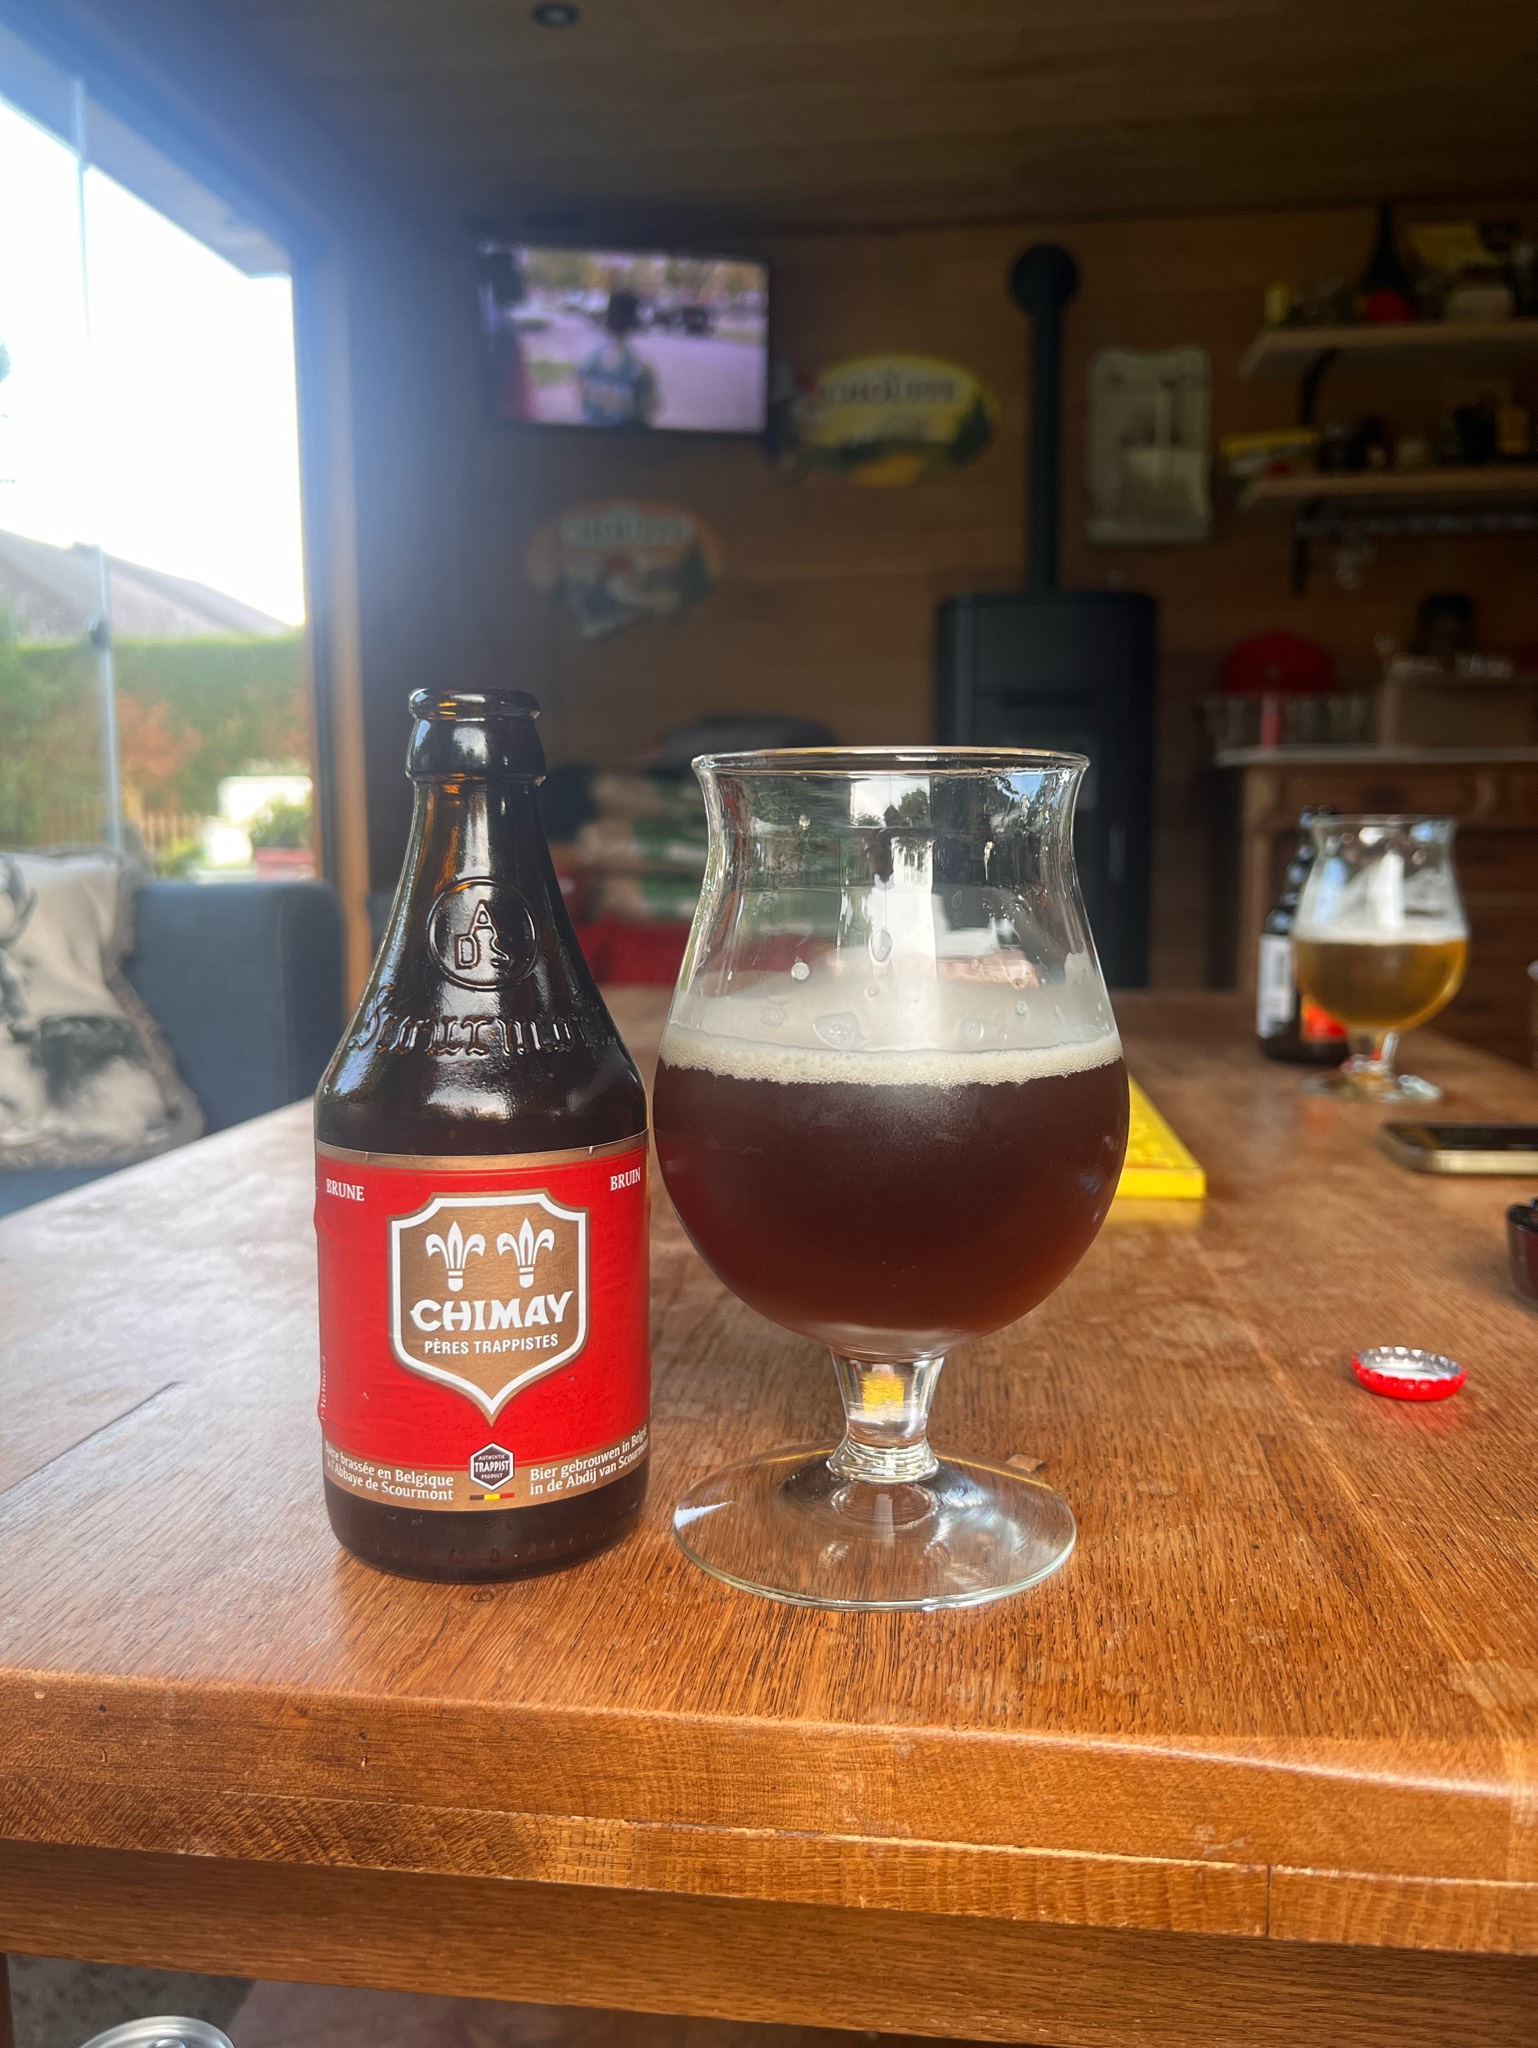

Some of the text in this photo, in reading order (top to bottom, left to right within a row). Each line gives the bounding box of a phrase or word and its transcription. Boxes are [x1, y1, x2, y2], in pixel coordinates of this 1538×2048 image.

[326, 1177, 365, 1202] BRUNE
[609, 1166, 641, 1191] BRUIN
[409, 1290, 574, 1332] CHIMAY
[424, 1333, 560, 1355] PÈRES TRAPPISTES
[340, 1451, 375, 1476] brassée
[377, 1468, 392, 1480] en
[395, 1469, 454, 1489] Belgique
[474, 1460, 510, 1473] TRAPPIST
[530, 1467, 558, 1482] Bier
[560, 1446, 620, 1478] gebrouwen
[621, 1441, 630, 1454] in
[365, 1476, 379, 1491] de
[381, 1481, 454, 1501] Scourmont
[480, 1472, 503, 1480] PRODUCT
[529, 1483, 543, 1496] in
[546, 1480, 563, 1493] de
[565, 1467, 597, 1489] Abdij
[599, 1462, 617, 1478] van
